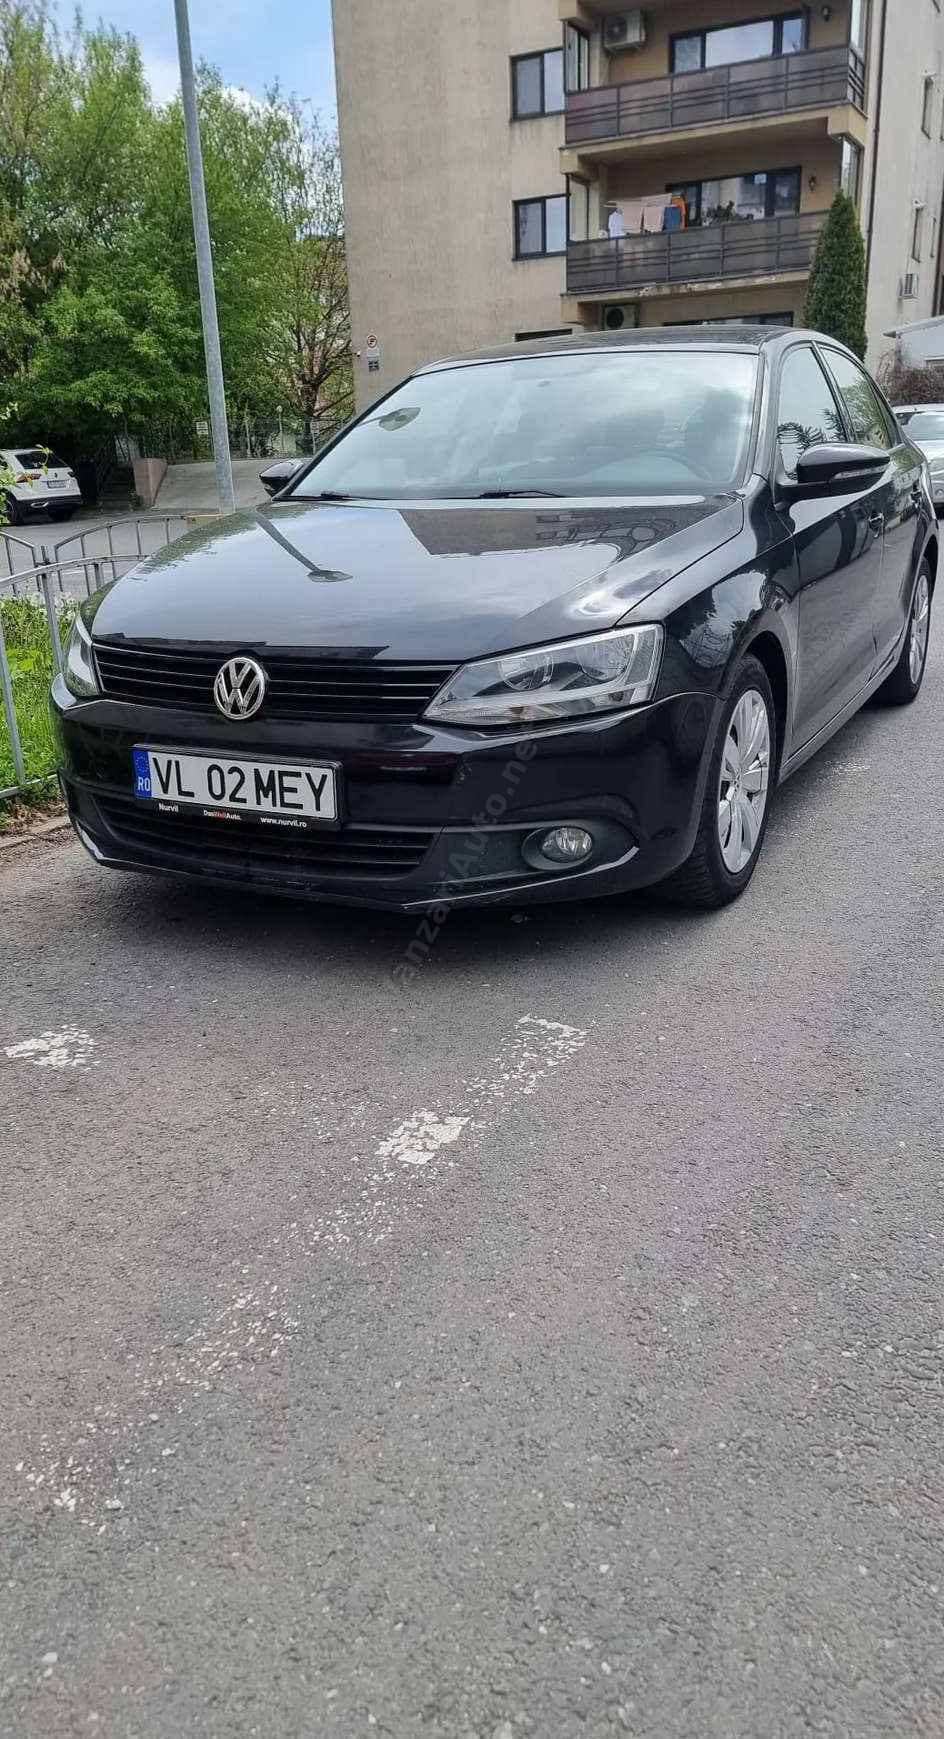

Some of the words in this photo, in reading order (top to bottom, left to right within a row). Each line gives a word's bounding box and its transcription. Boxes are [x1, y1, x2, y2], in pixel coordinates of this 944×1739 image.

[137, 776, 151, 792] RO
[152, 757, 195, 798] VL
[206, 764, 247, 804] 02
[253, 768, 328, 812] MEY
